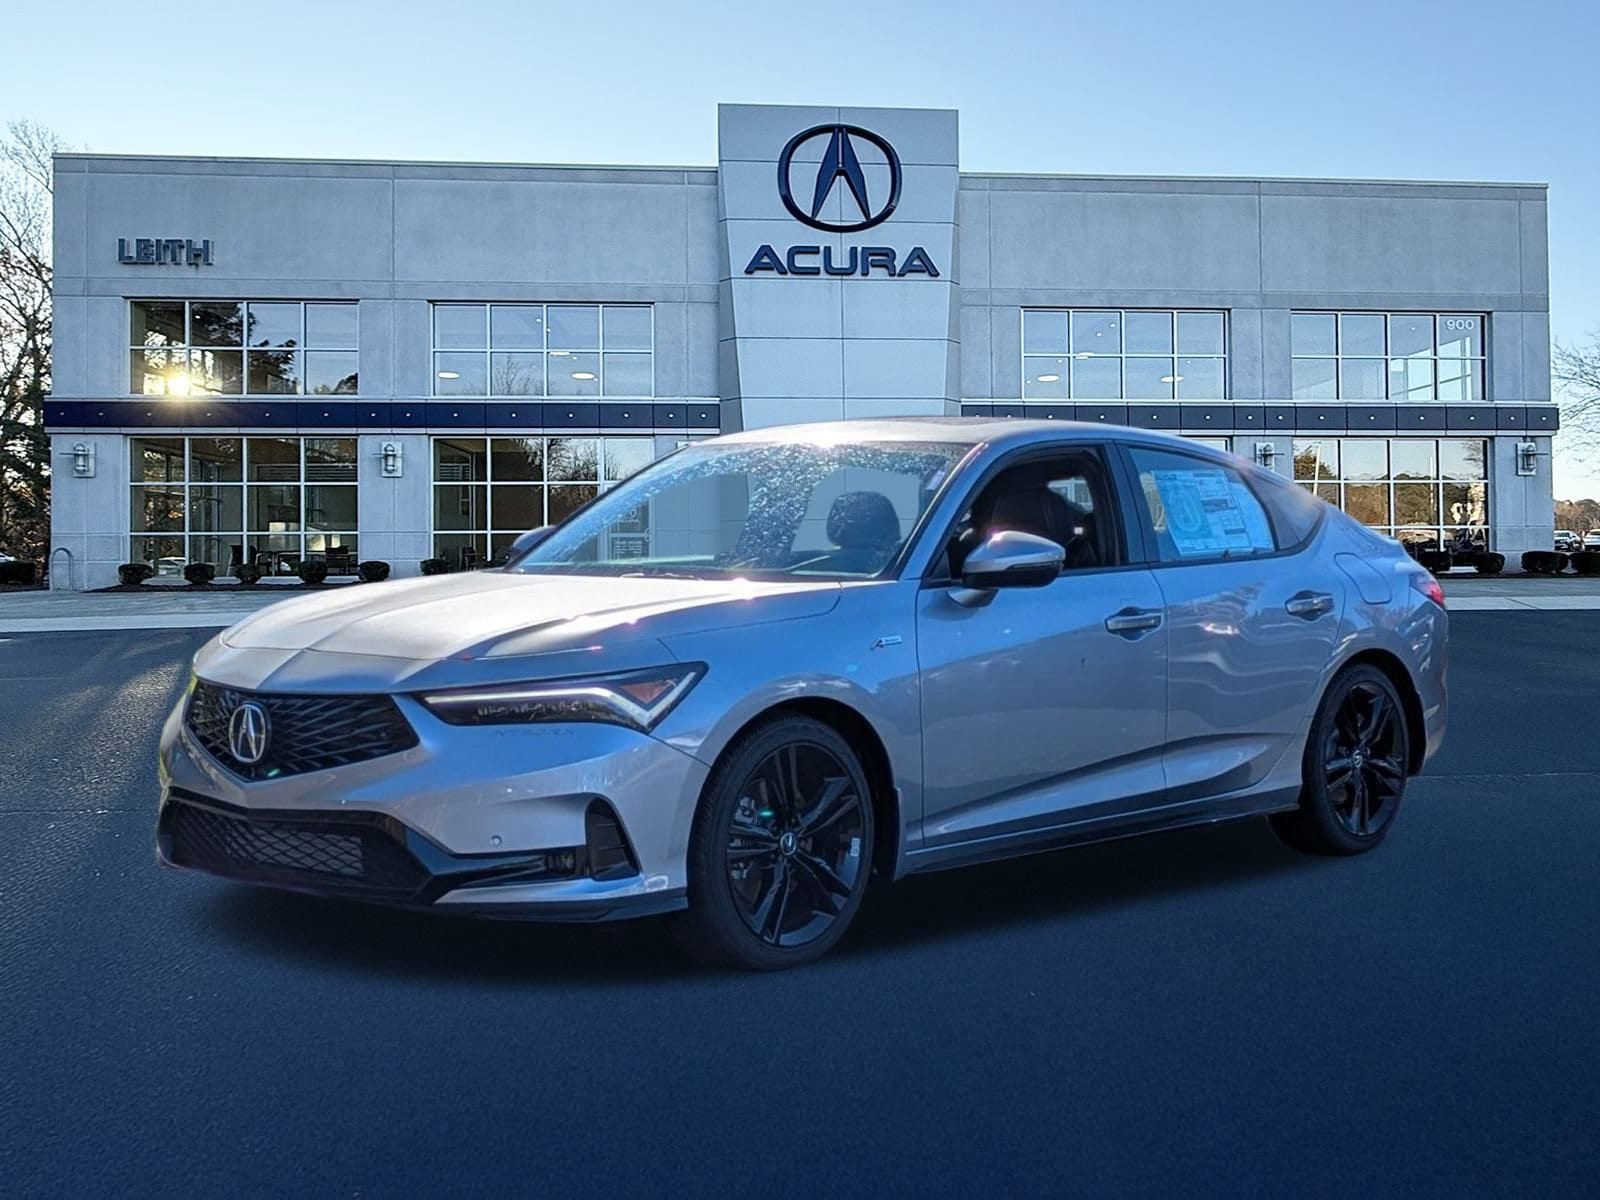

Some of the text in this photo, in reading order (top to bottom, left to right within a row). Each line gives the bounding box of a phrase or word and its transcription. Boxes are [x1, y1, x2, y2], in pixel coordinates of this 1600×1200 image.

[118, 238, 213, 265] LEITH
[744, 244, 940, 277] ACURA
[1446, 319, 1474, 330] 900
